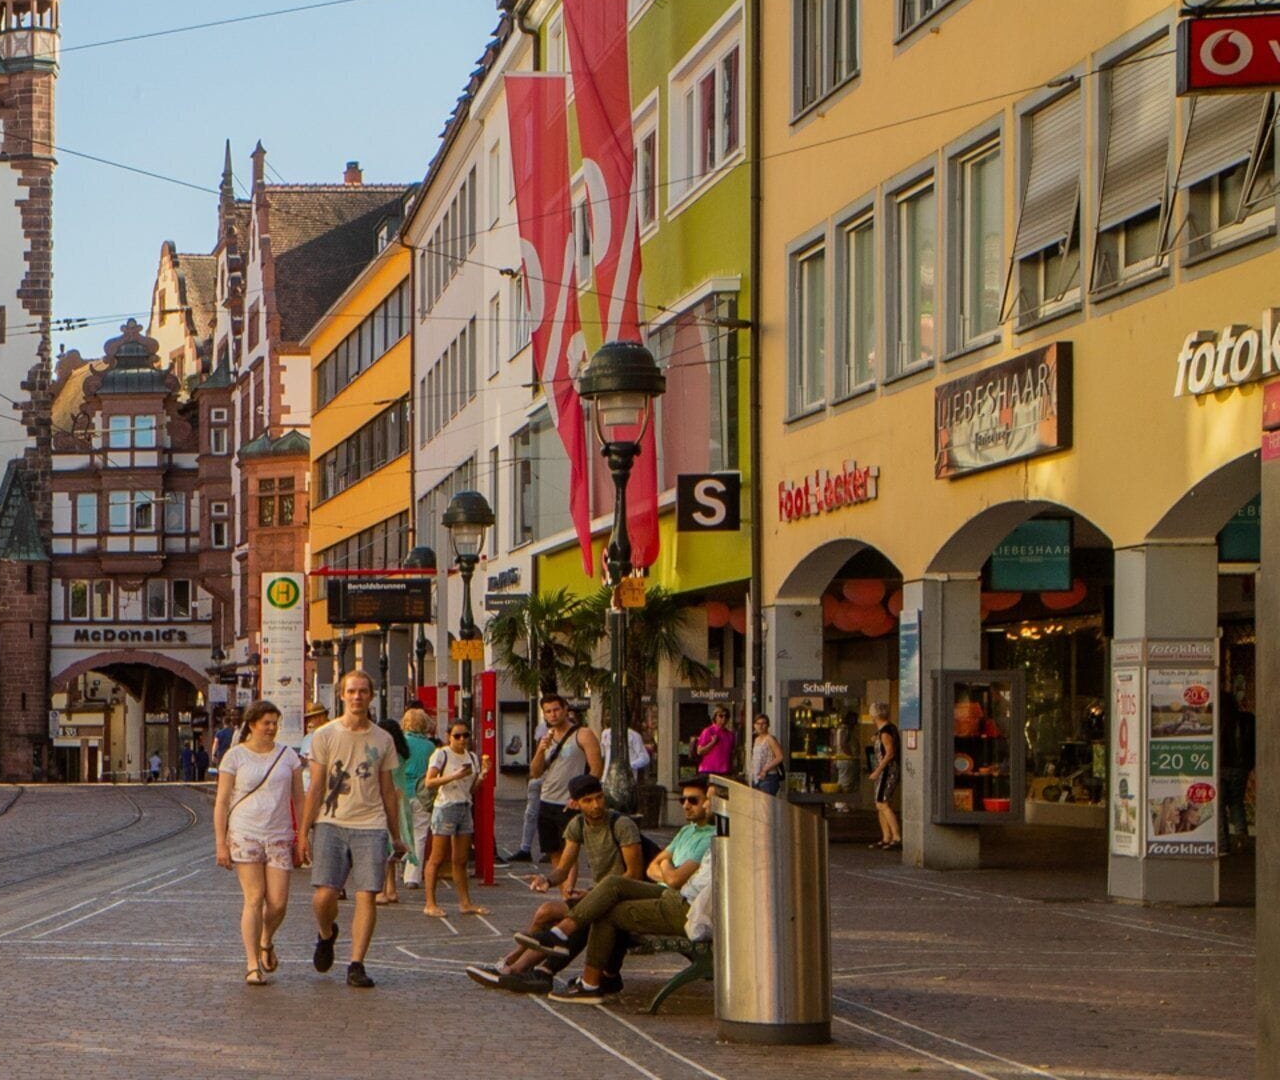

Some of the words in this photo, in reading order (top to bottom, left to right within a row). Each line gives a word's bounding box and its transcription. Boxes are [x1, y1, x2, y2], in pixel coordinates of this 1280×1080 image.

[936, 362, 1051, 430] LIEBESHAAR
[692, 478, 727, 527] S
[778, 480, 811, 522] Foot
[347, 582, 407, 591] Bertoldsbrunnen
[73, 628, 188, 642] McDonald's
[1149, 643, 1212, 654] fotoklick
[690, 689, 730, 701] Schafferer
[803, 683, 848, 695] Schafferer
[1151, 753, 1184, 770] -20
[1190, 753, 1209, 770] %
[1148, 842, 1215, 854] fotoklick
